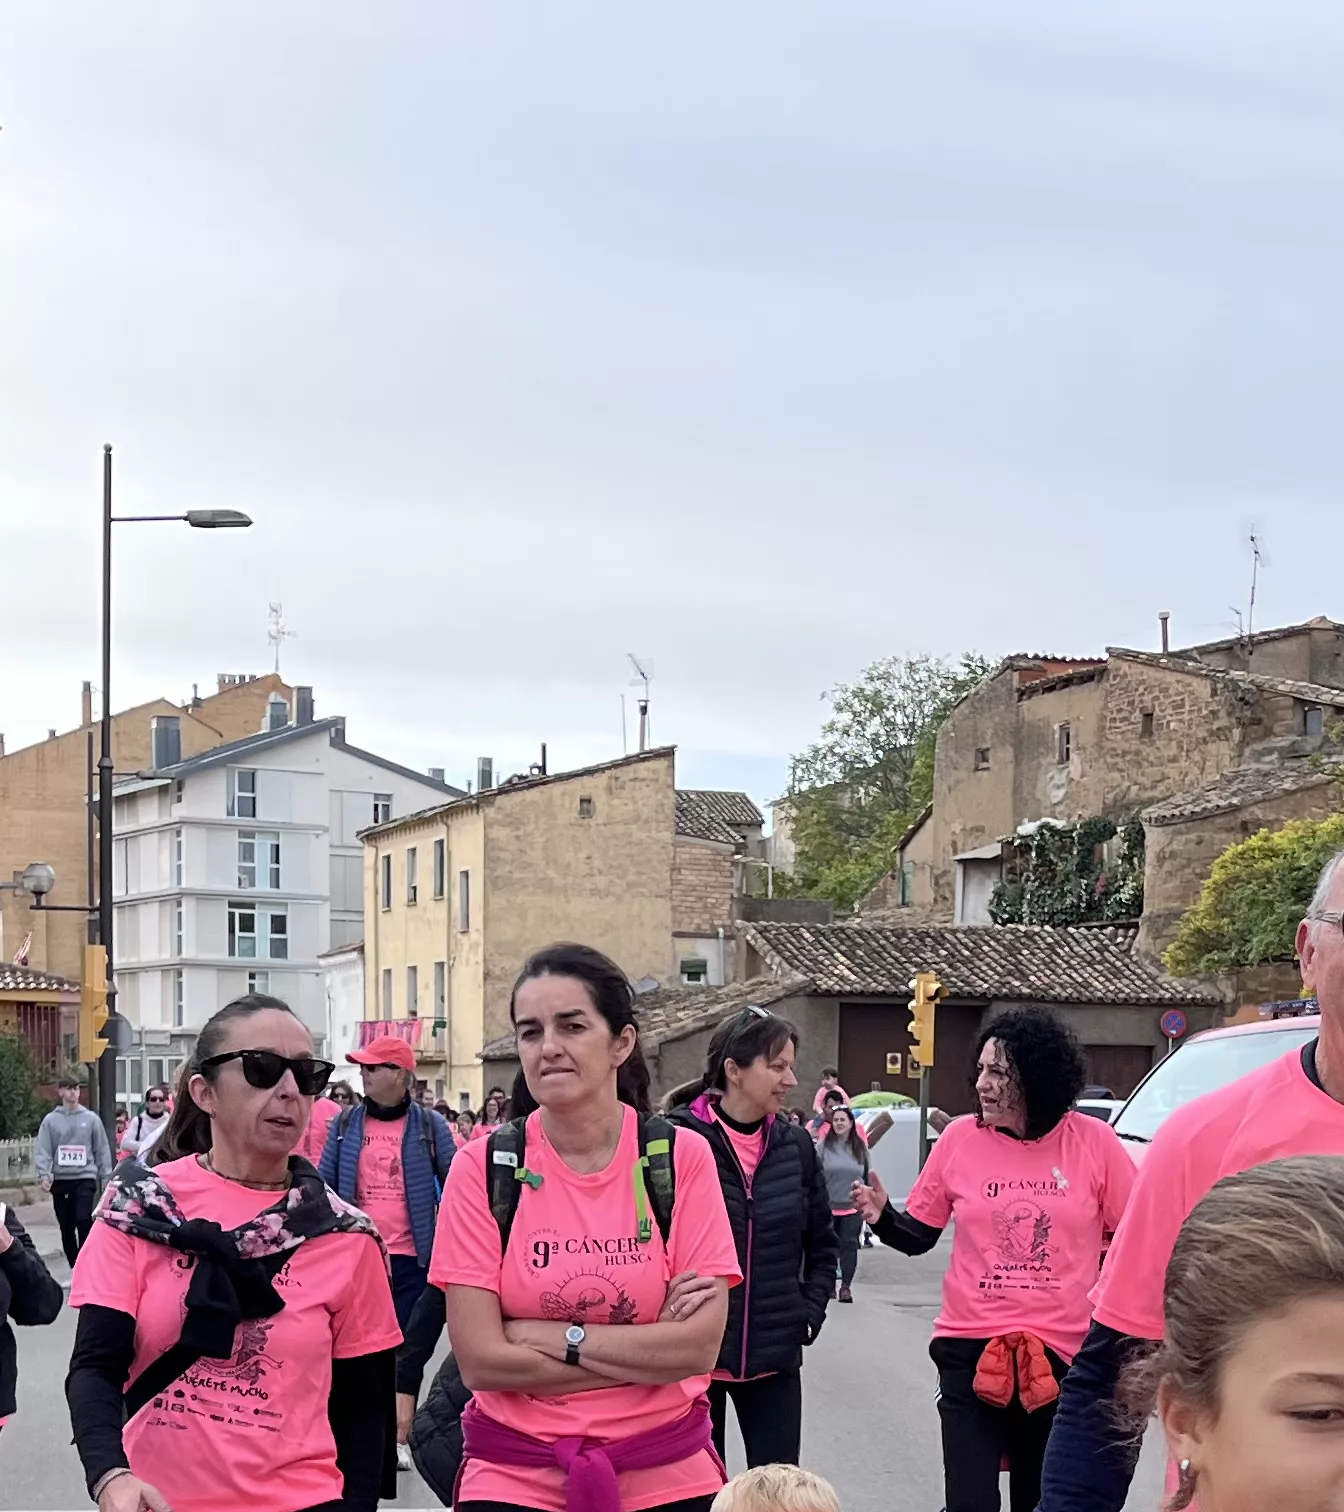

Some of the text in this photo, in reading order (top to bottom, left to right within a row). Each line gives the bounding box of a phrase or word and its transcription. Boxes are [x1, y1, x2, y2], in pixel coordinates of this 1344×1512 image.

[532, 1234, 639, 1268] 9ª CÁNCER
[605, 1253, 652, 1266] HUESCA
[230, 1384, 268, 1401] MUCHO
